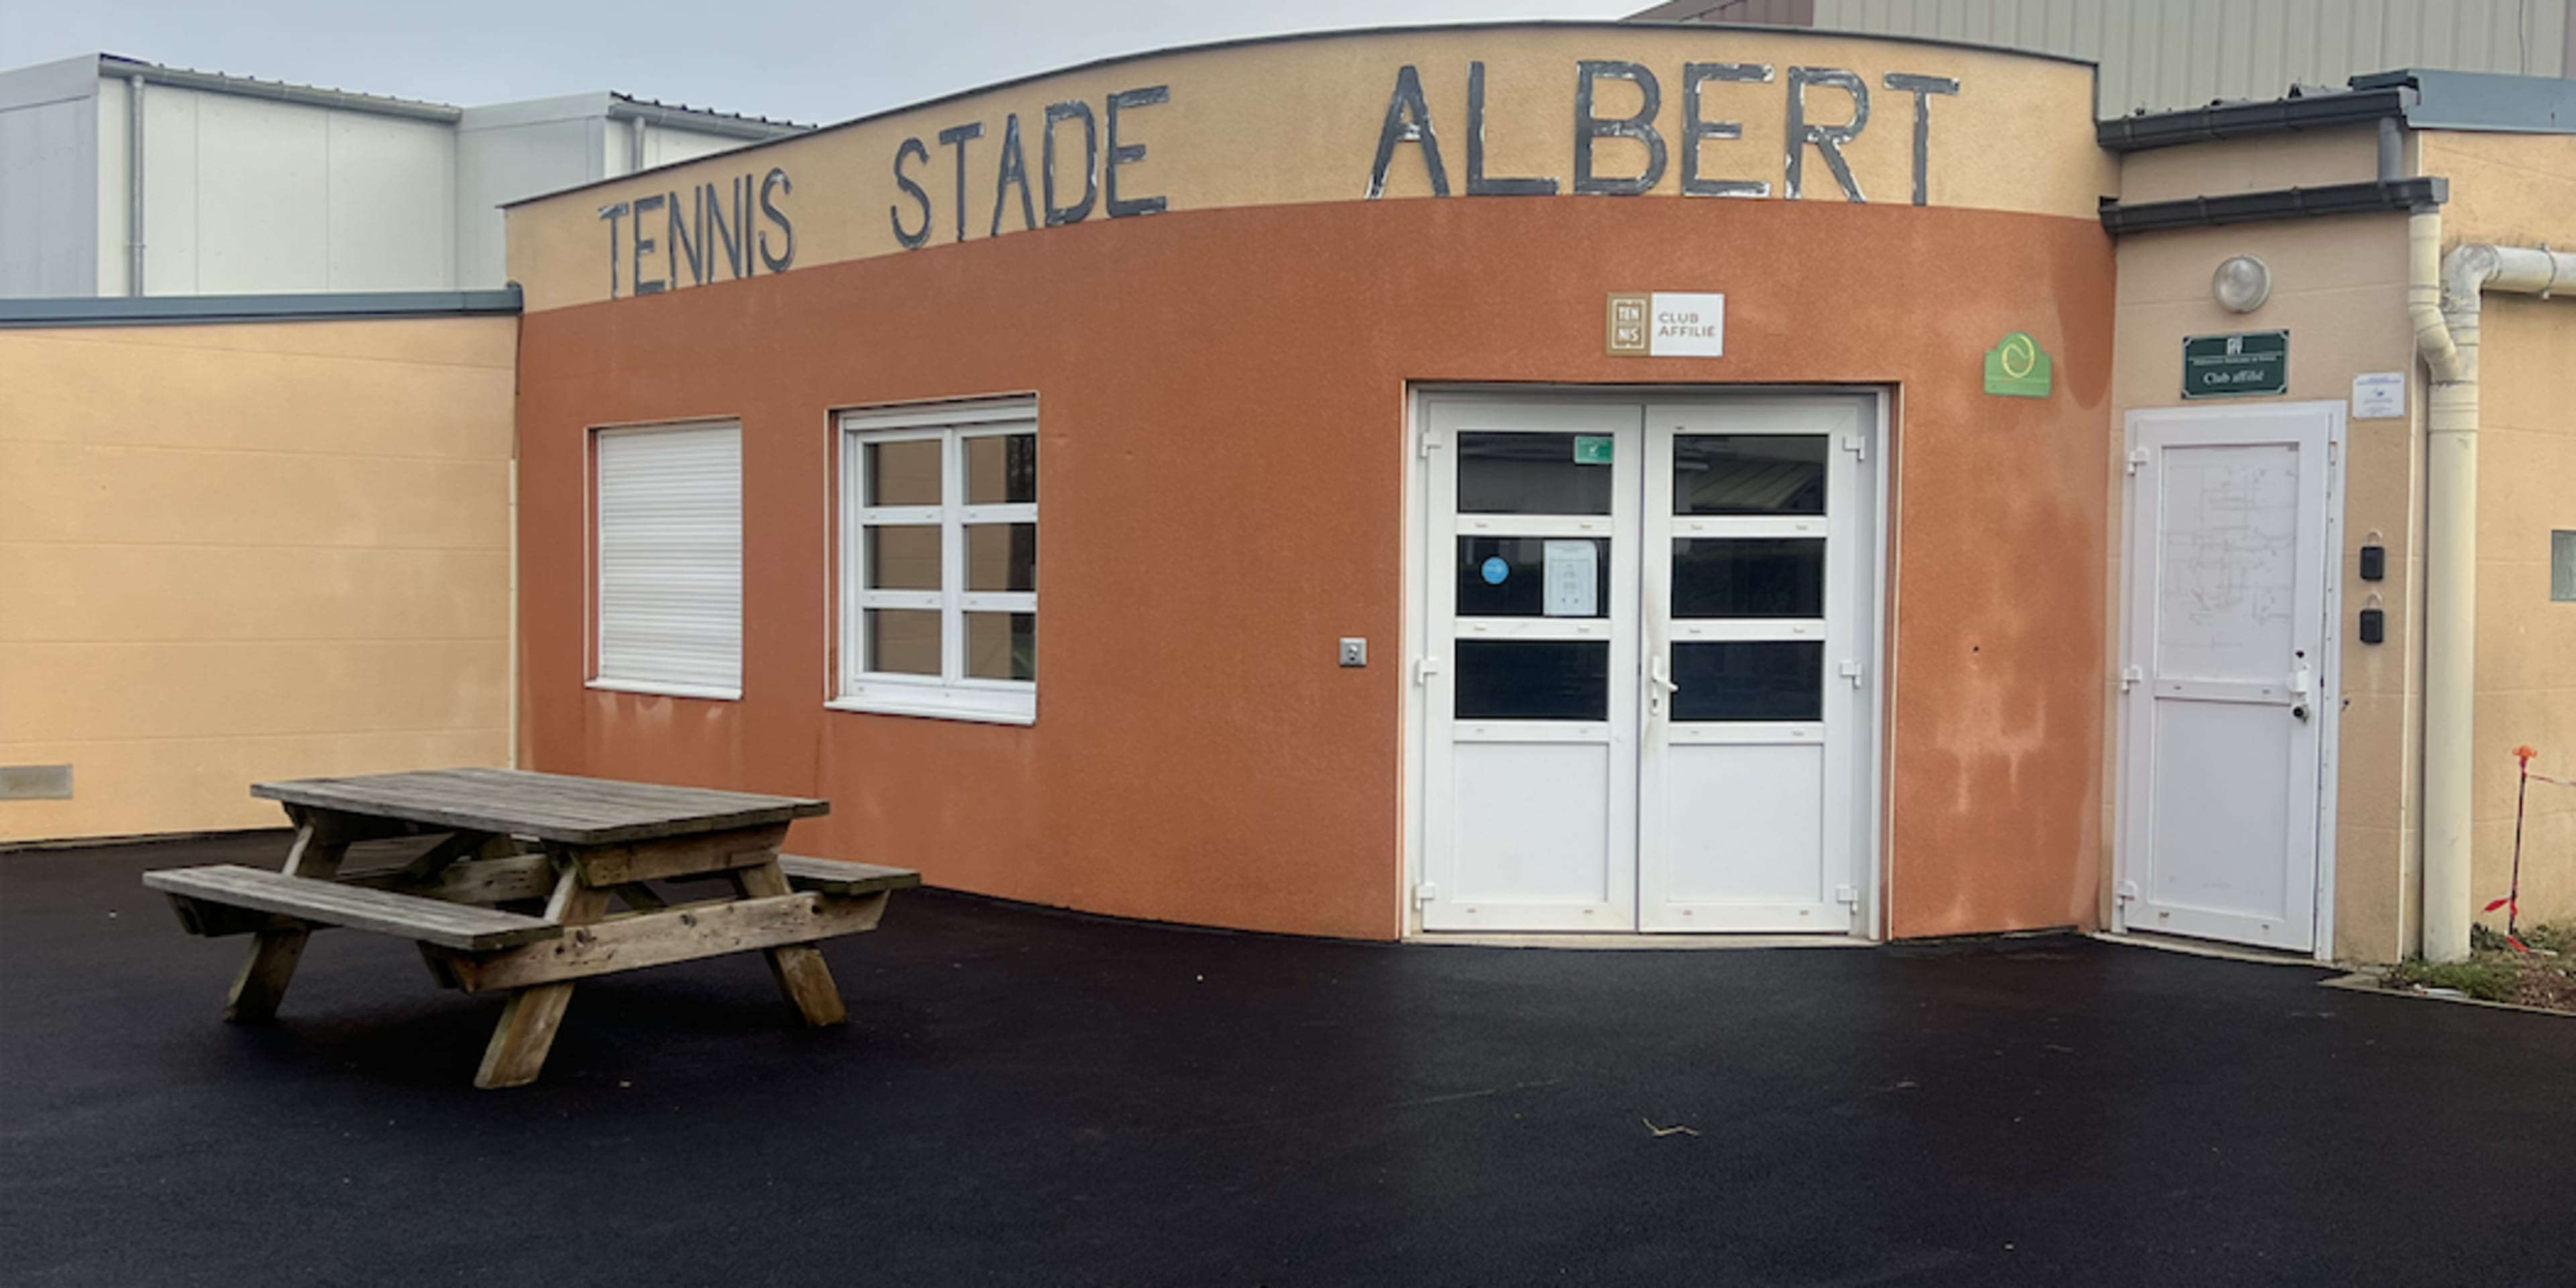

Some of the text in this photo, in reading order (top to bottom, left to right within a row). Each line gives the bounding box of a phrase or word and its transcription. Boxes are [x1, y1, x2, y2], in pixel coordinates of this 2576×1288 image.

[598, 60, 1960, 299] TENNIS STADE ALBERT
[1658, 311, 1699, 324] CLUB
